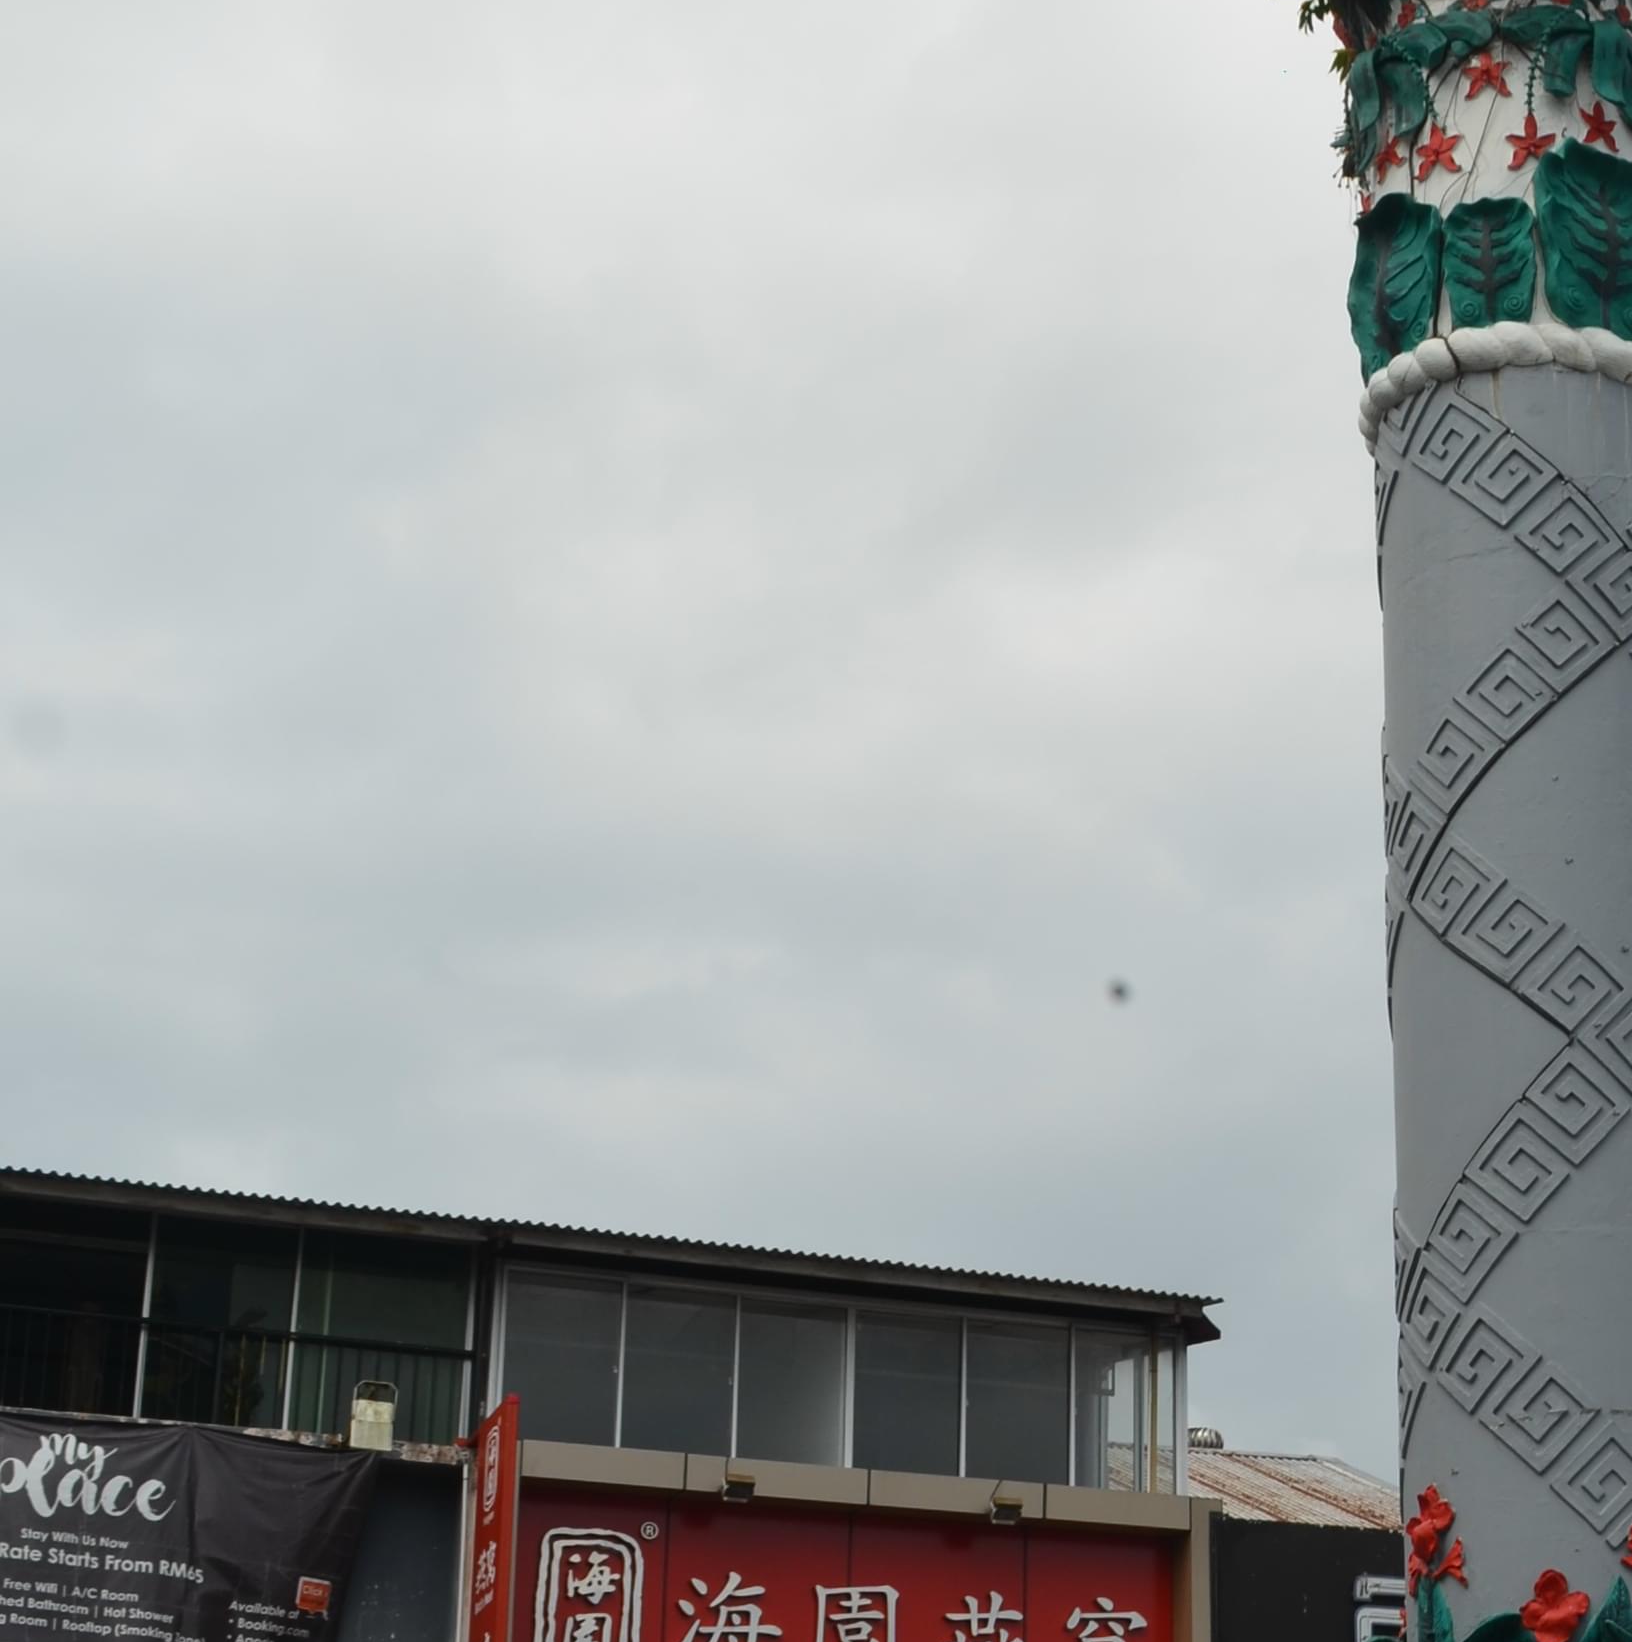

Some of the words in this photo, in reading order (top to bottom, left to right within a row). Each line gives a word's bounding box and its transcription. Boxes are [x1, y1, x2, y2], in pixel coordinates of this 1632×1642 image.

[20, 1527, 50, 1543] Stay
[51, 1530, 79, 1545] With
[82, 1534, 97, 1547] Us
[99, 1536, 129, 1550] Now
[0, 1541, 43, 1562] Rate
[47, 1547, 100, 1569] Starts
[104, 1554, 154, 1574] From
[159, 1559, 205, 1585] RM65
[3, 1577, 32, 1591] Free
[71, 1585, 99, 1599] A/C
[100, 1588, 140, 1603] Room
[26, 1597, 89, 1616] Bathroom
[103, 1605, 127, 1619] Hot
[128, 1607, 175, 1625] Shower
[228, 1600, 287, 1618] Available
[9, 1612, 49, 1628] Room
[61, 1618, 113, 1637] Rooftop
[236, 1617, 310, 1638] Booking.com
